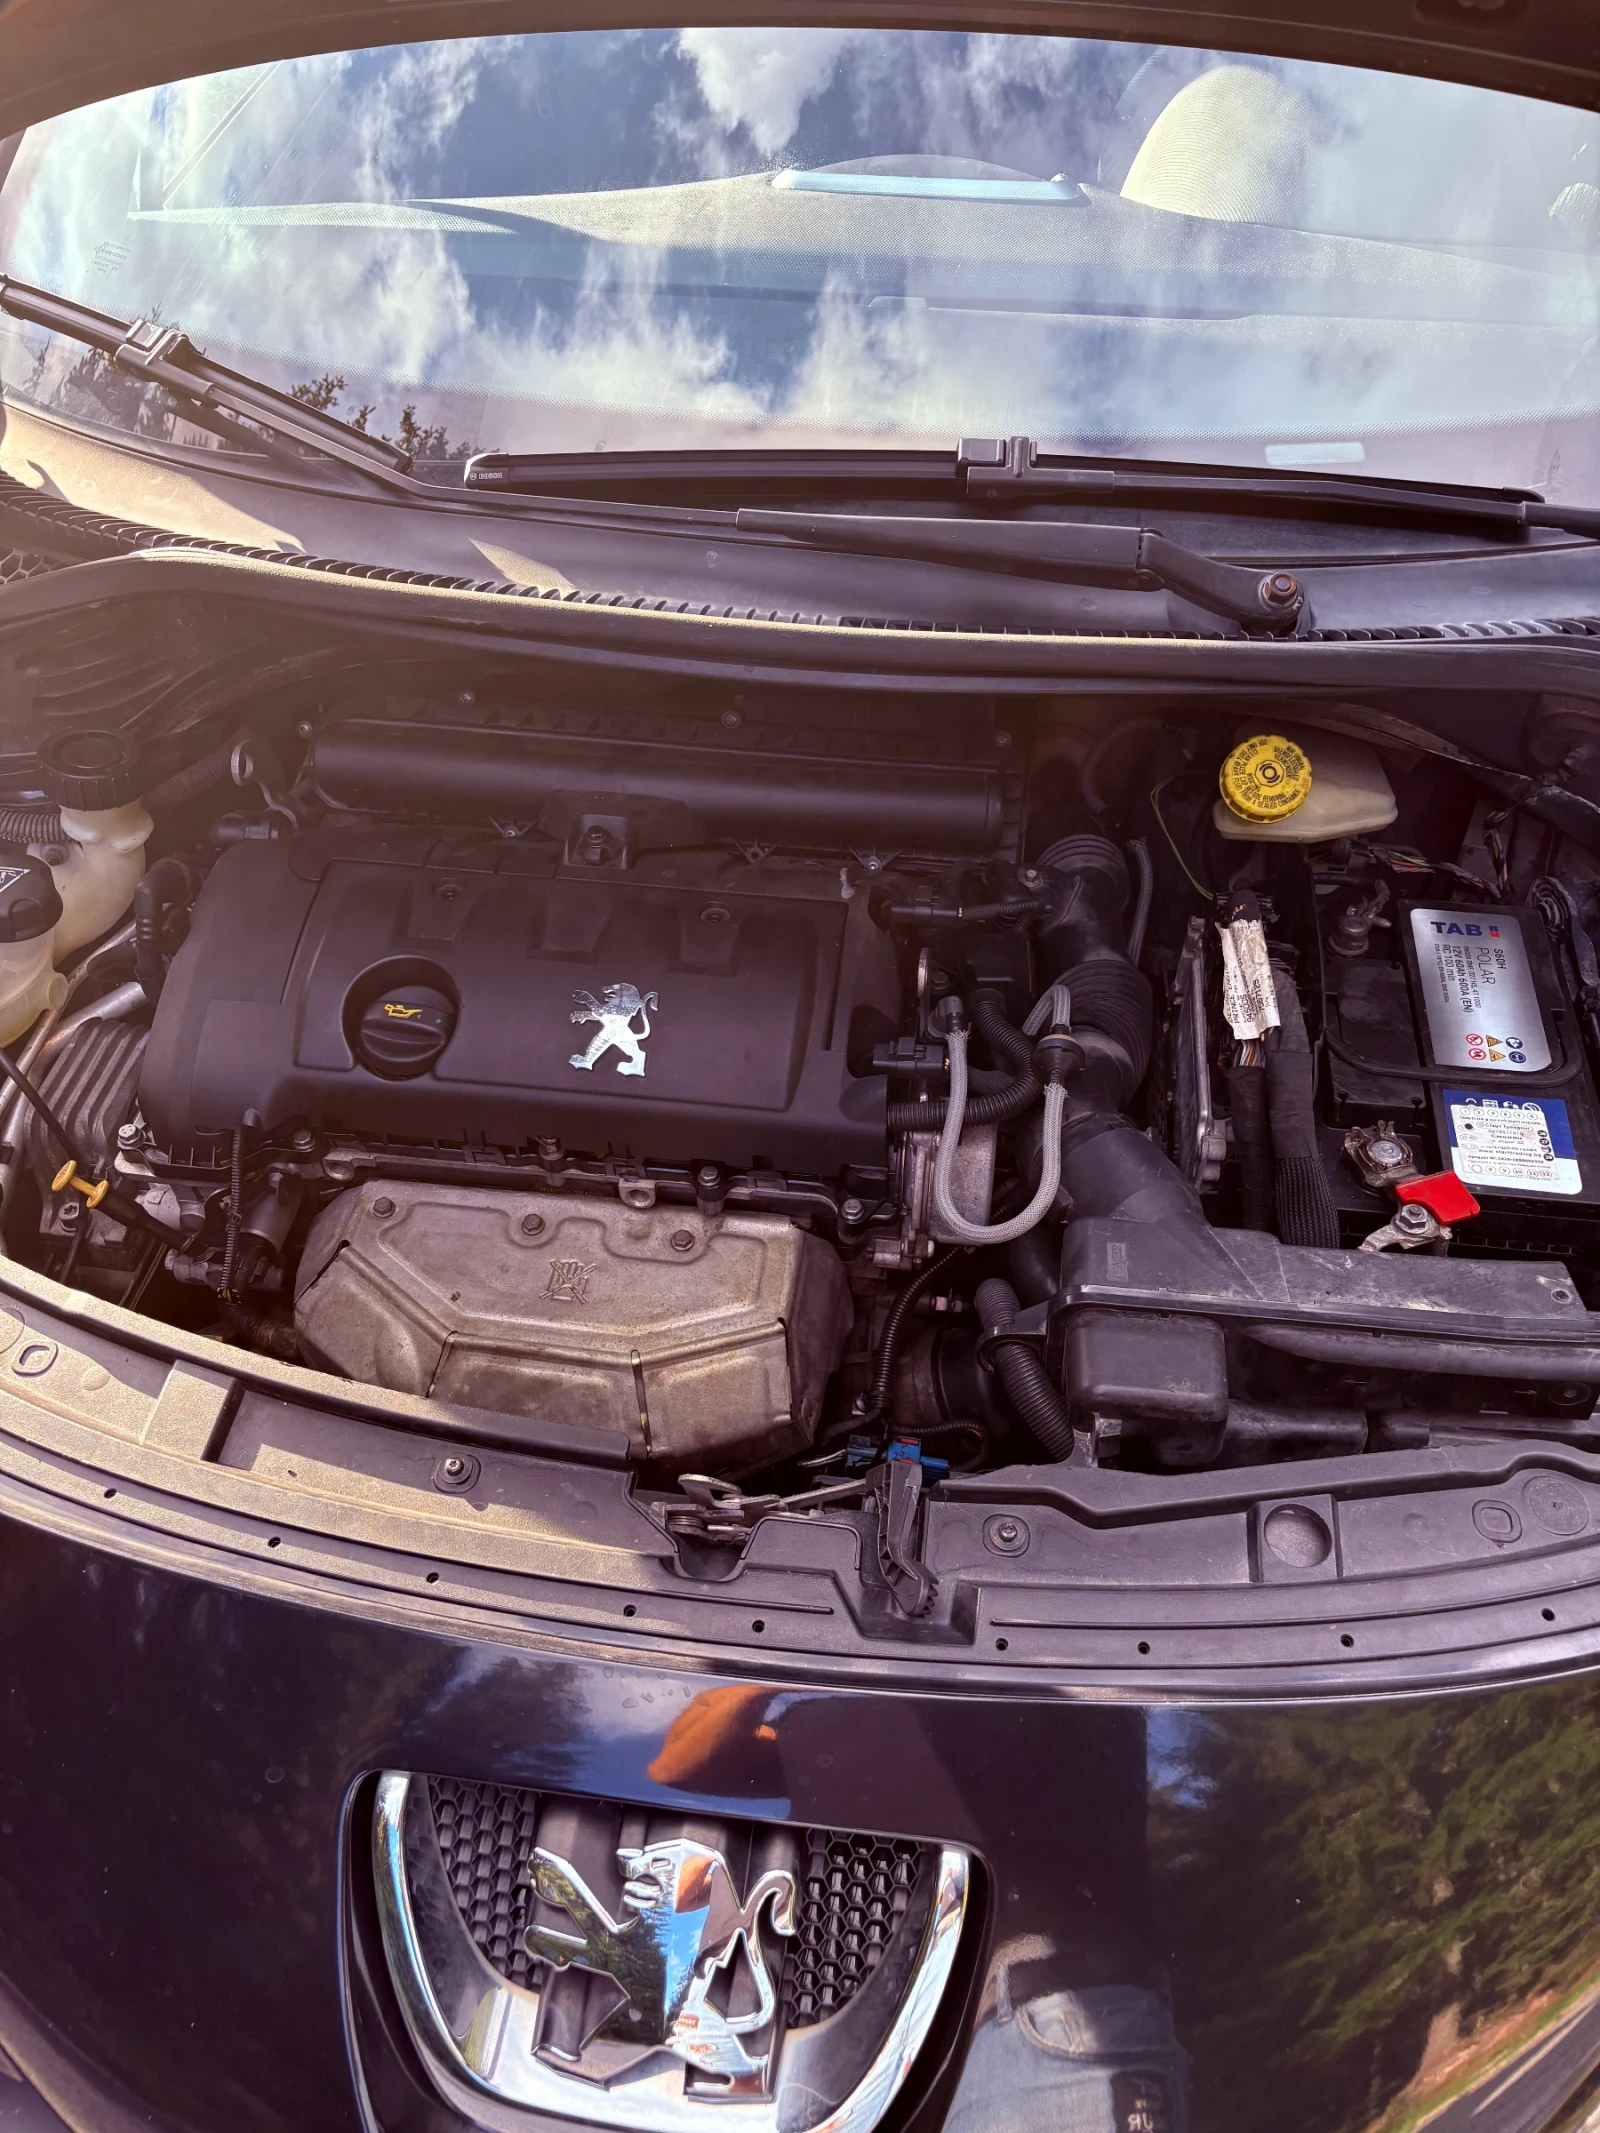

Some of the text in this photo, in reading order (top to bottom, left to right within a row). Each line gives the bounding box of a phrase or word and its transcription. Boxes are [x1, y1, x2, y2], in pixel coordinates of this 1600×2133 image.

[1243, 748, 1259, 762] CLEAN
[1256, 801, 1277, 809] SEALED
[1430, 921, 1483, 936] TAB
[1442, 944, 1457, 981] RC 100 min
[1475, 946, 1496, 984] POLAR
[1494, 948, 1507, 970] S60H
[1452, 945, 1474, 1013] 12V 60Ah 600A (EN)
[1230, 995, 1240, 1023] PRINCE
